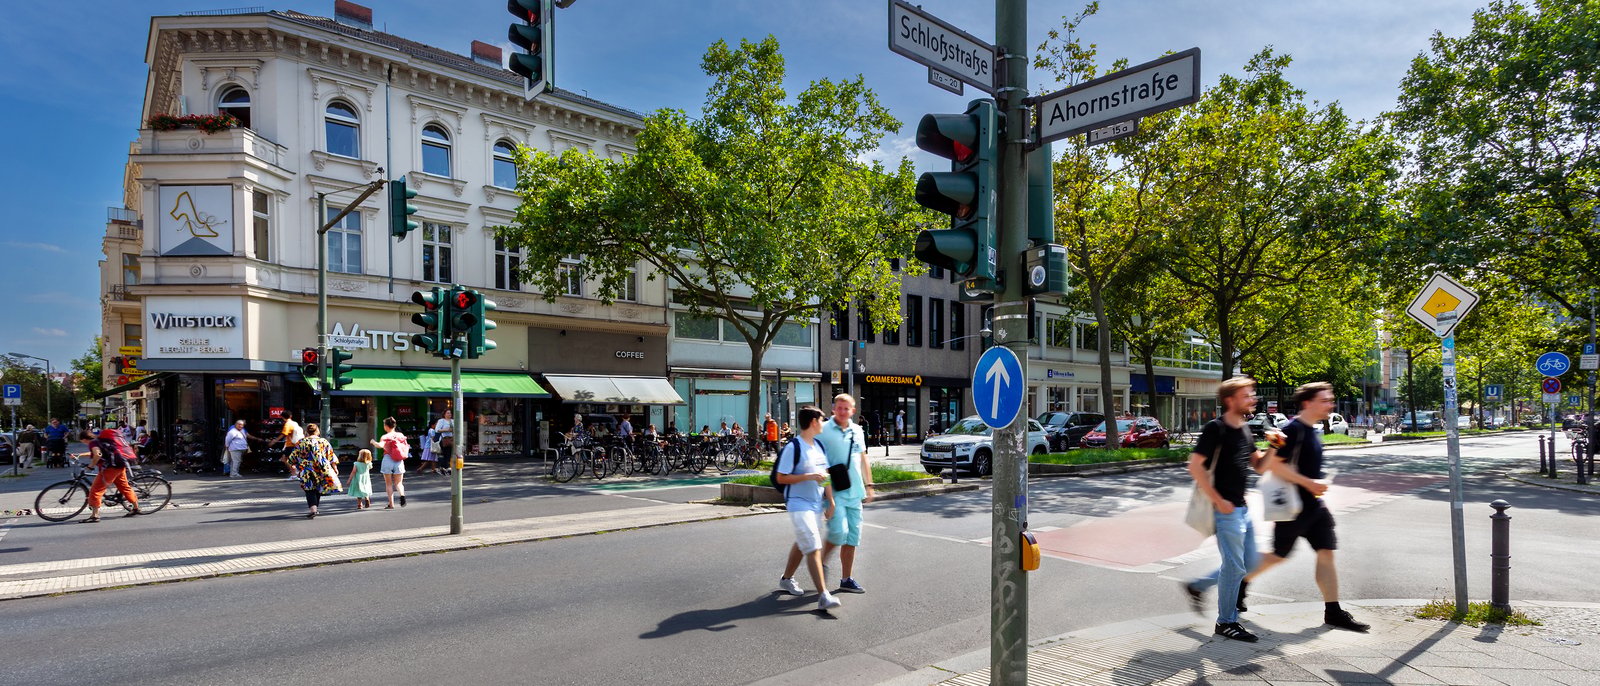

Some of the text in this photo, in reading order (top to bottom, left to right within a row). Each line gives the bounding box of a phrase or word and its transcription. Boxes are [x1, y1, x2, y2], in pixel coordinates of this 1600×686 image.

[901, 15, 988, 76] Schloßstraße
[950, 78, 958, 88] 20
[1049, 72, 1178, 126] Ahornstraße
[179, 338, 210, 346] SCHUHE
[159, 346, 192, 354] ELEGANT
[199, 346, 231, 354] BEQUEM
[1586, 345, 1593, 353] P
[615, 350, 645, 359] COFFEE
[866, 375, 914, 384] COMMERZBANK
[7, 386, 17, 397] P
[1488, 387, 1497, 396] U
